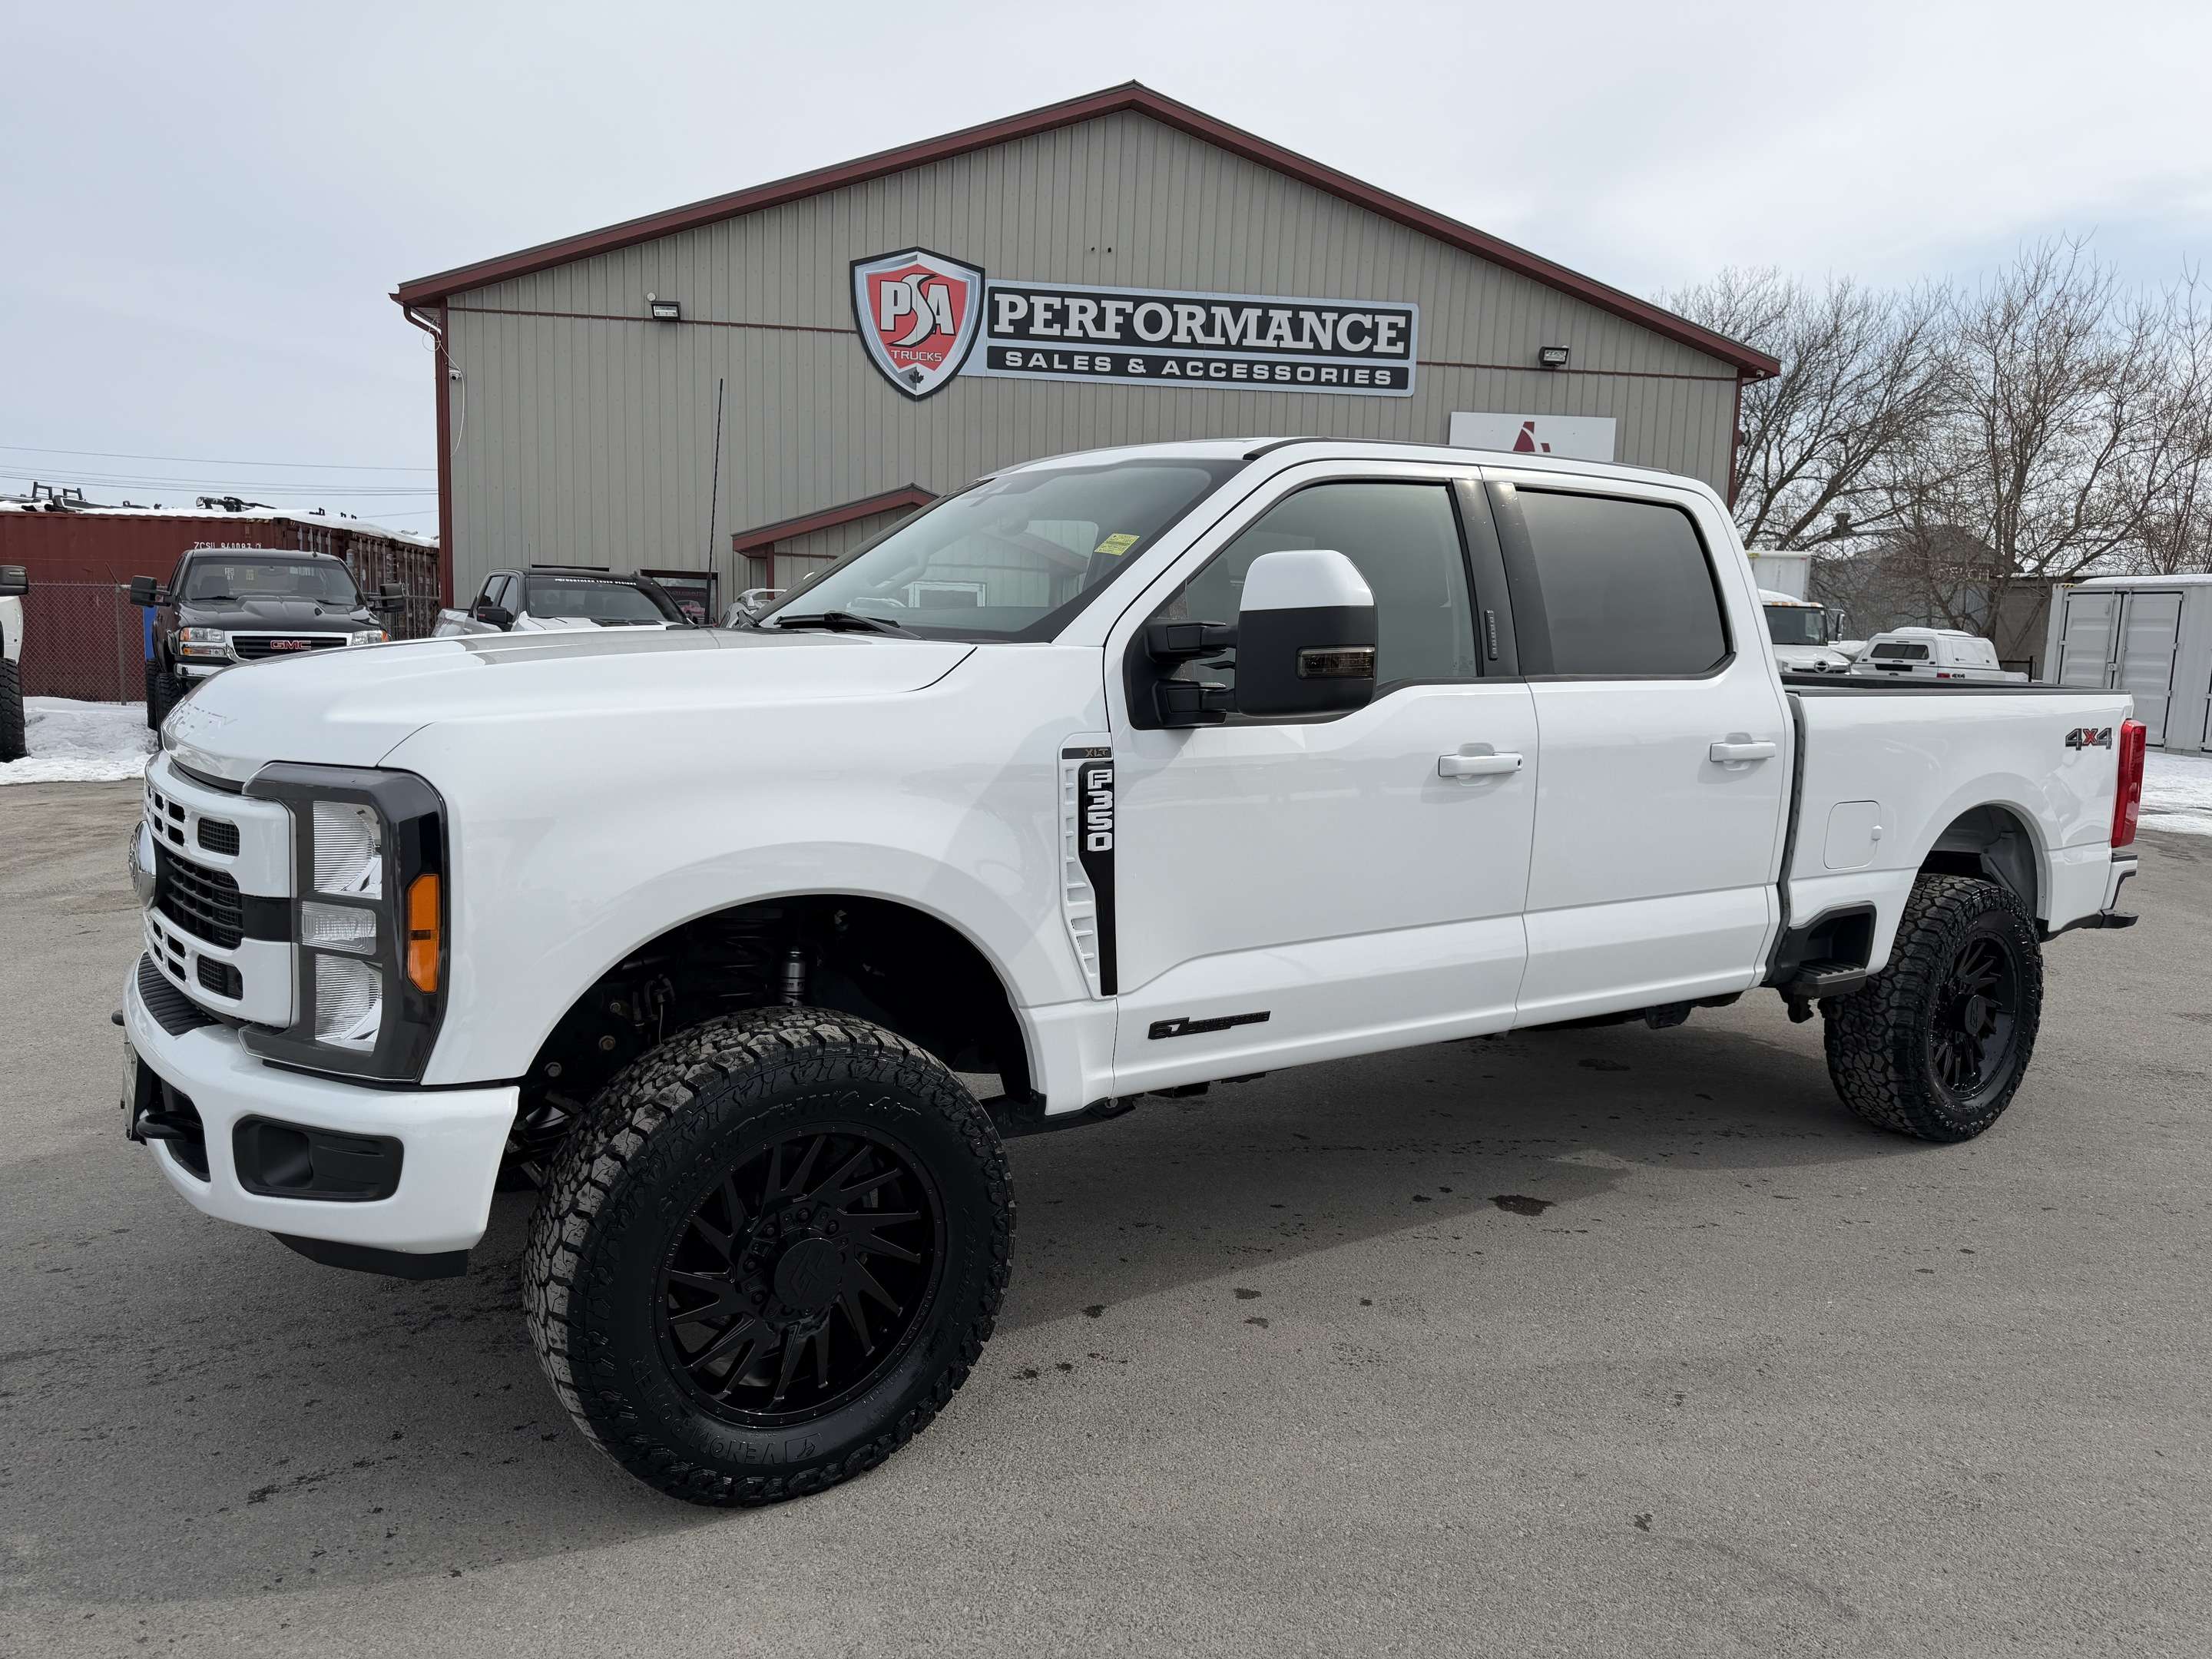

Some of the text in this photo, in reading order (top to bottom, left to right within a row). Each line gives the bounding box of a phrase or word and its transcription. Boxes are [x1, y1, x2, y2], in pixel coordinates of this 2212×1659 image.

[879, 273, 956, 348] PSA
[994, 293, 1406, 354] PERFORMANCE
[891, 349, 942, 362] TRUCKS
[1005, 351, 1391, 385] SALES & ACCESSORIES
[270, 641, 311, 650] GMC
[1084, 747, 1108, 757] XLT
[1087, 769, 1113, 852] F350
